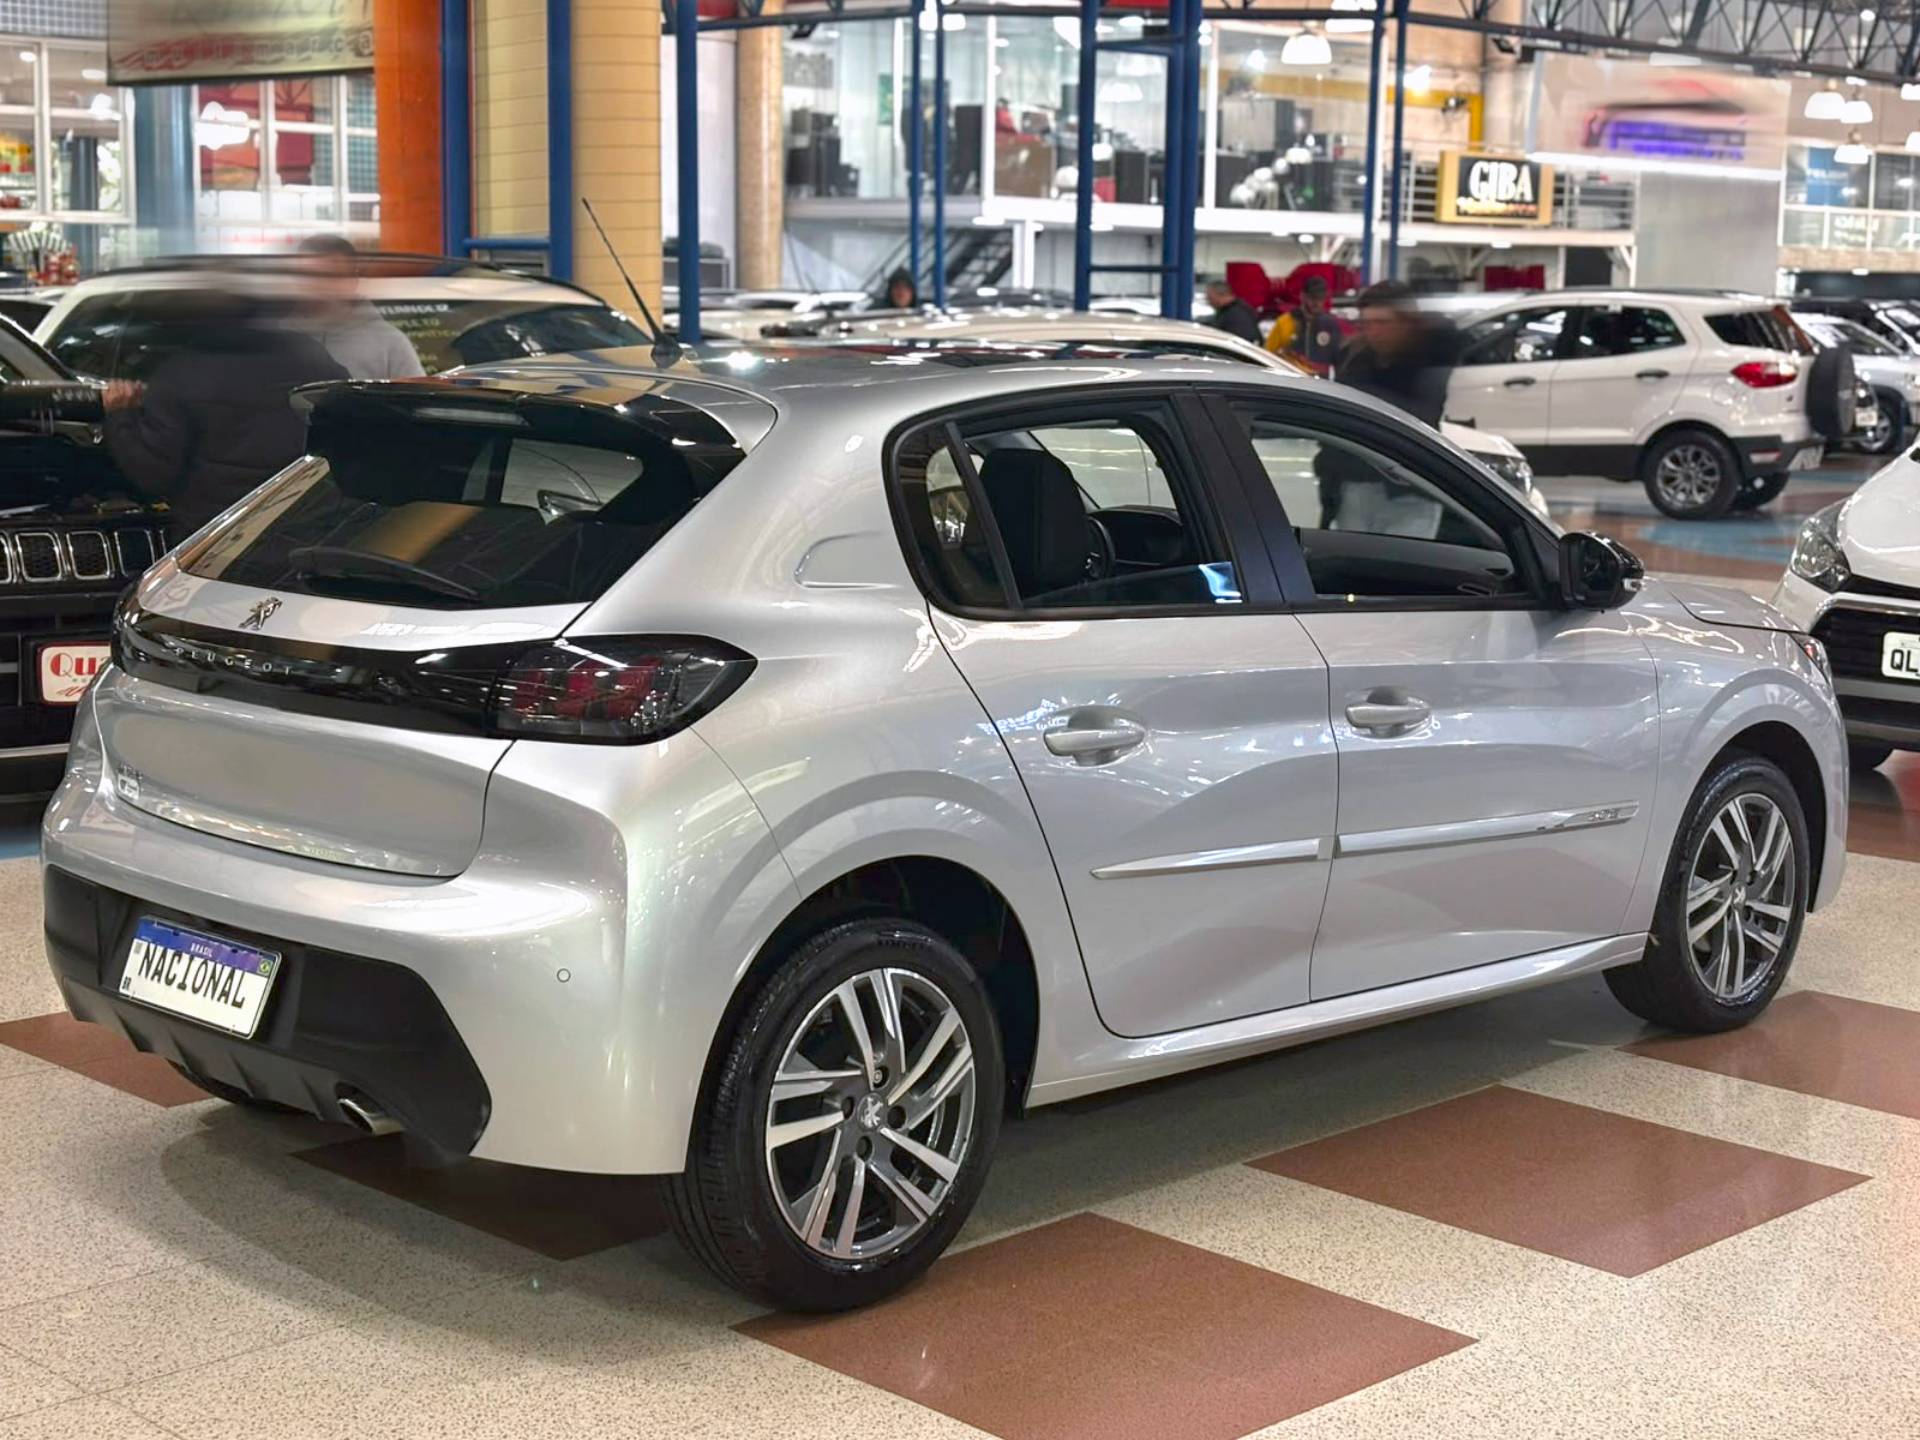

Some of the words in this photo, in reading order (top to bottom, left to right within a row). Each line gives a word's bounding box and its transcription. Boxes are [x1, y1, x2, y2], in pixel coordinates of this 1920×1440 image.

[1469, 160, 1533, 202] GIBA
[50, 652, 111, 678] Qu
[175, 646, 292, 676] PEUGEOT
[1890, 648, 1920, 678] QL
[138, 942, 246, 1009] NACIONAL
